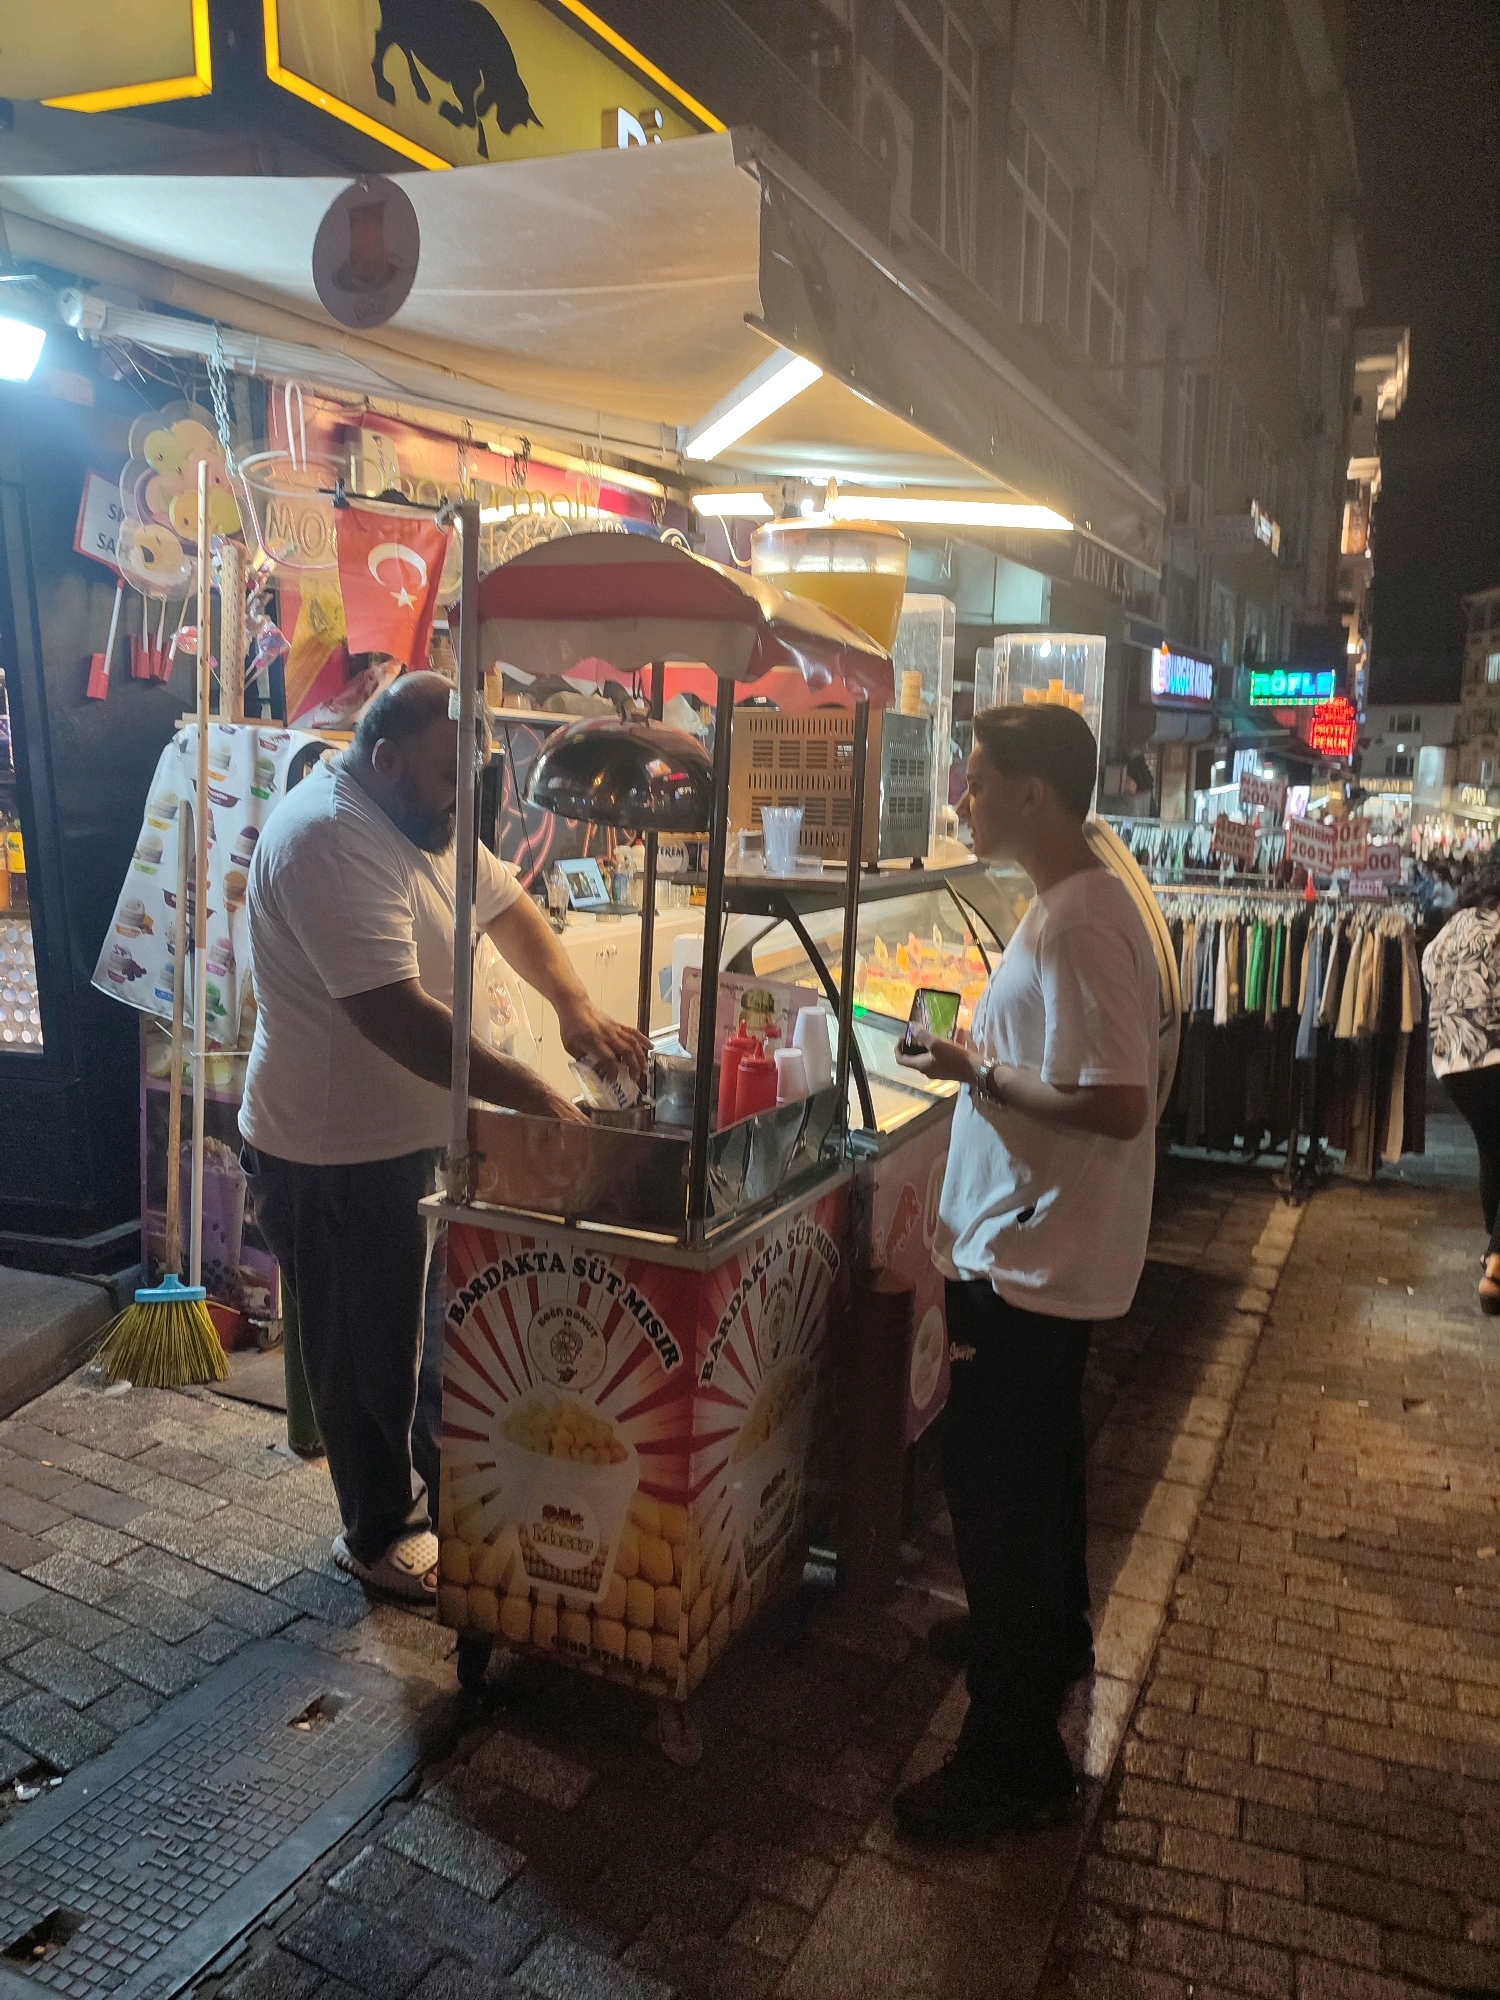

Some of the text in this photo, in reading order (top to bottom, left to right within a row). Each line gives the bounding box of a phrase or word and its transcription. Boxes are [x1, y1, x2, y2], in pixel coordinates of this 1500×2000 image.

[448, 1252, 566, 1327] BARDAKTA
[572, 1253, 623, 1296] SÜT
[623, 1288, 680, 1371] MISIR
[700, 1239, 784, 1383] BARDAKTA
[786, 1219, 815, 1250] SÜT
[813, 1228, 840, 1279] MISIR
